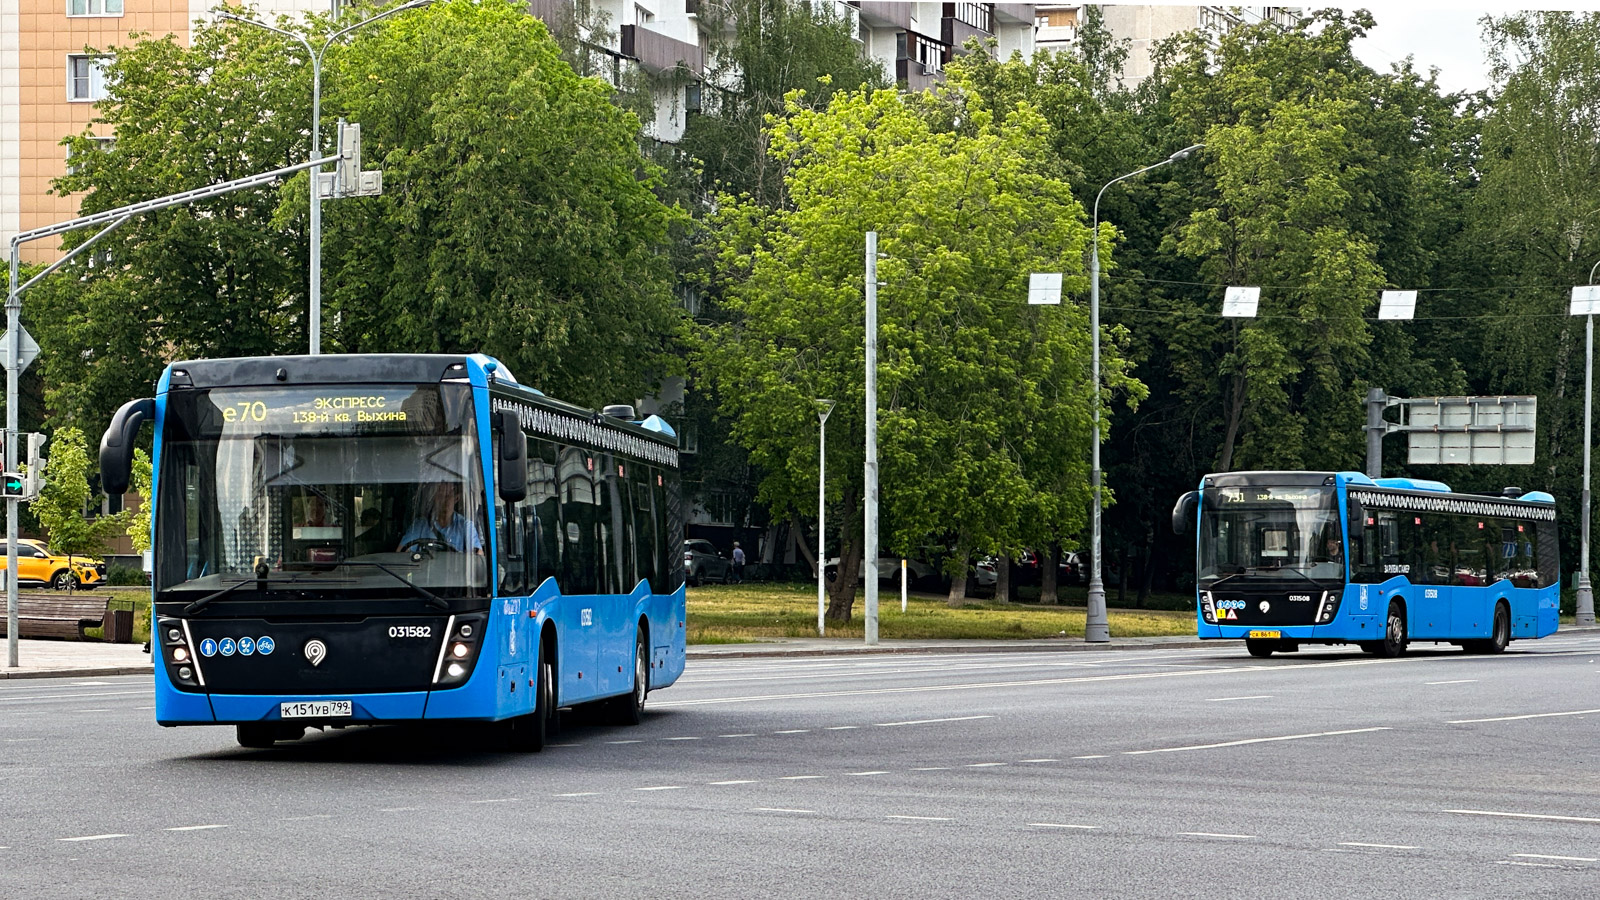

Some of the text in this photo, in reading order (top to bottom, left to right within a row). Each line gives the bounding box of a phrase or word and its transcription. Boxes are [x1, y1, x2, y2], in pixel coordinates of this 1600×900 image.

[314, 396, 386, 409] ЭКСПРЕСС
[292, 410, 407, 423] 138-й кв. Выхина
[1227, 492, 1245, 503] 731
[388, 626, 431, 638] 031582
[284, 701, 348, 716] К151УВ 799
